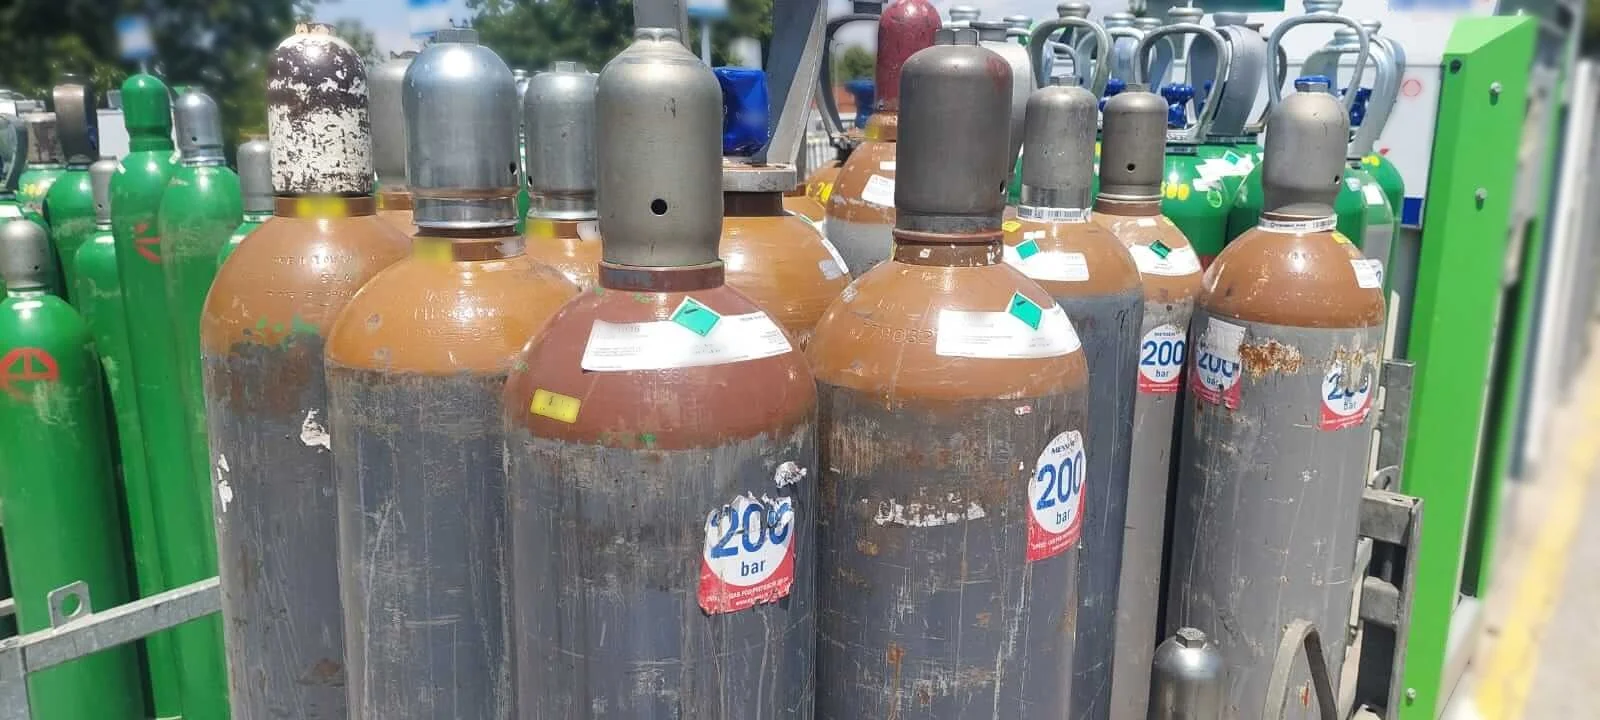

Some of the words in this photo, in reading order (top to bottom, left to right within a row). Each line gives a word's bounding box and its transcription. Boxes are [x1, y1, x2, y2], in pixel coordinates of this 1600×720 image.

[1141, 340, 1184, 366] 200
[1155, 369, 1169, 378] bar
[1036, 450, 1083, 511] 200
[1056, 509, 1071, 525] bar
[741, 560, 766, 577] bar
